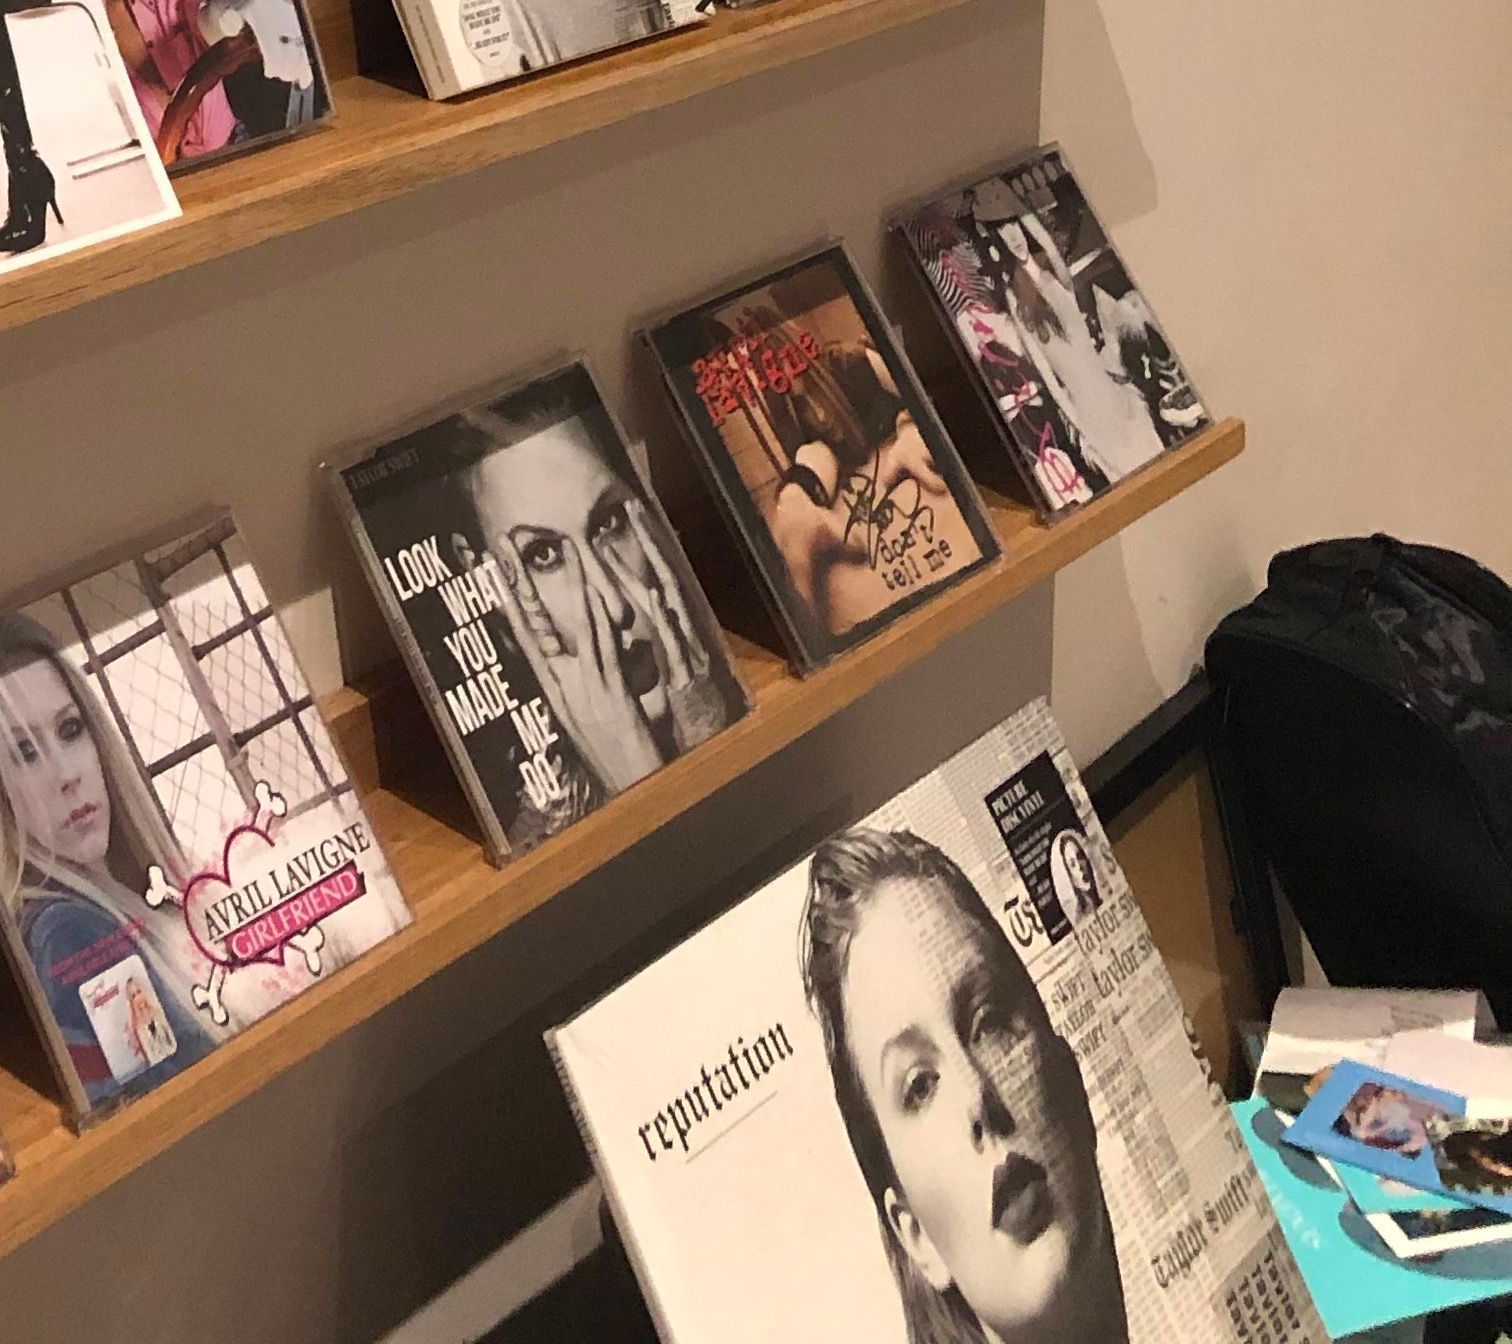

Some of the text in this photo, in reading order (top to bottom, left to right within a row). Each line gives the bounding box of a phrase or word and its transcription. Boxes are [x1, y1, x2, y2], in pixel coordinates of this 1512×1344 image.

[384, 534, 453, 602] LOOK
[438, 559, 509, 628] WHAT
[443, 618, 498, 679] YOU
[444, 663, 519, 737] MADE
[510, 697, 559, 756] ME
[518, 752, 561, 809] DO
[203, 821, 371, 941] AVRIL LAVIGNE
[231, 869, 358, 959] GIRLFRIEND
[638, 1021, 794, 1162] reputation
